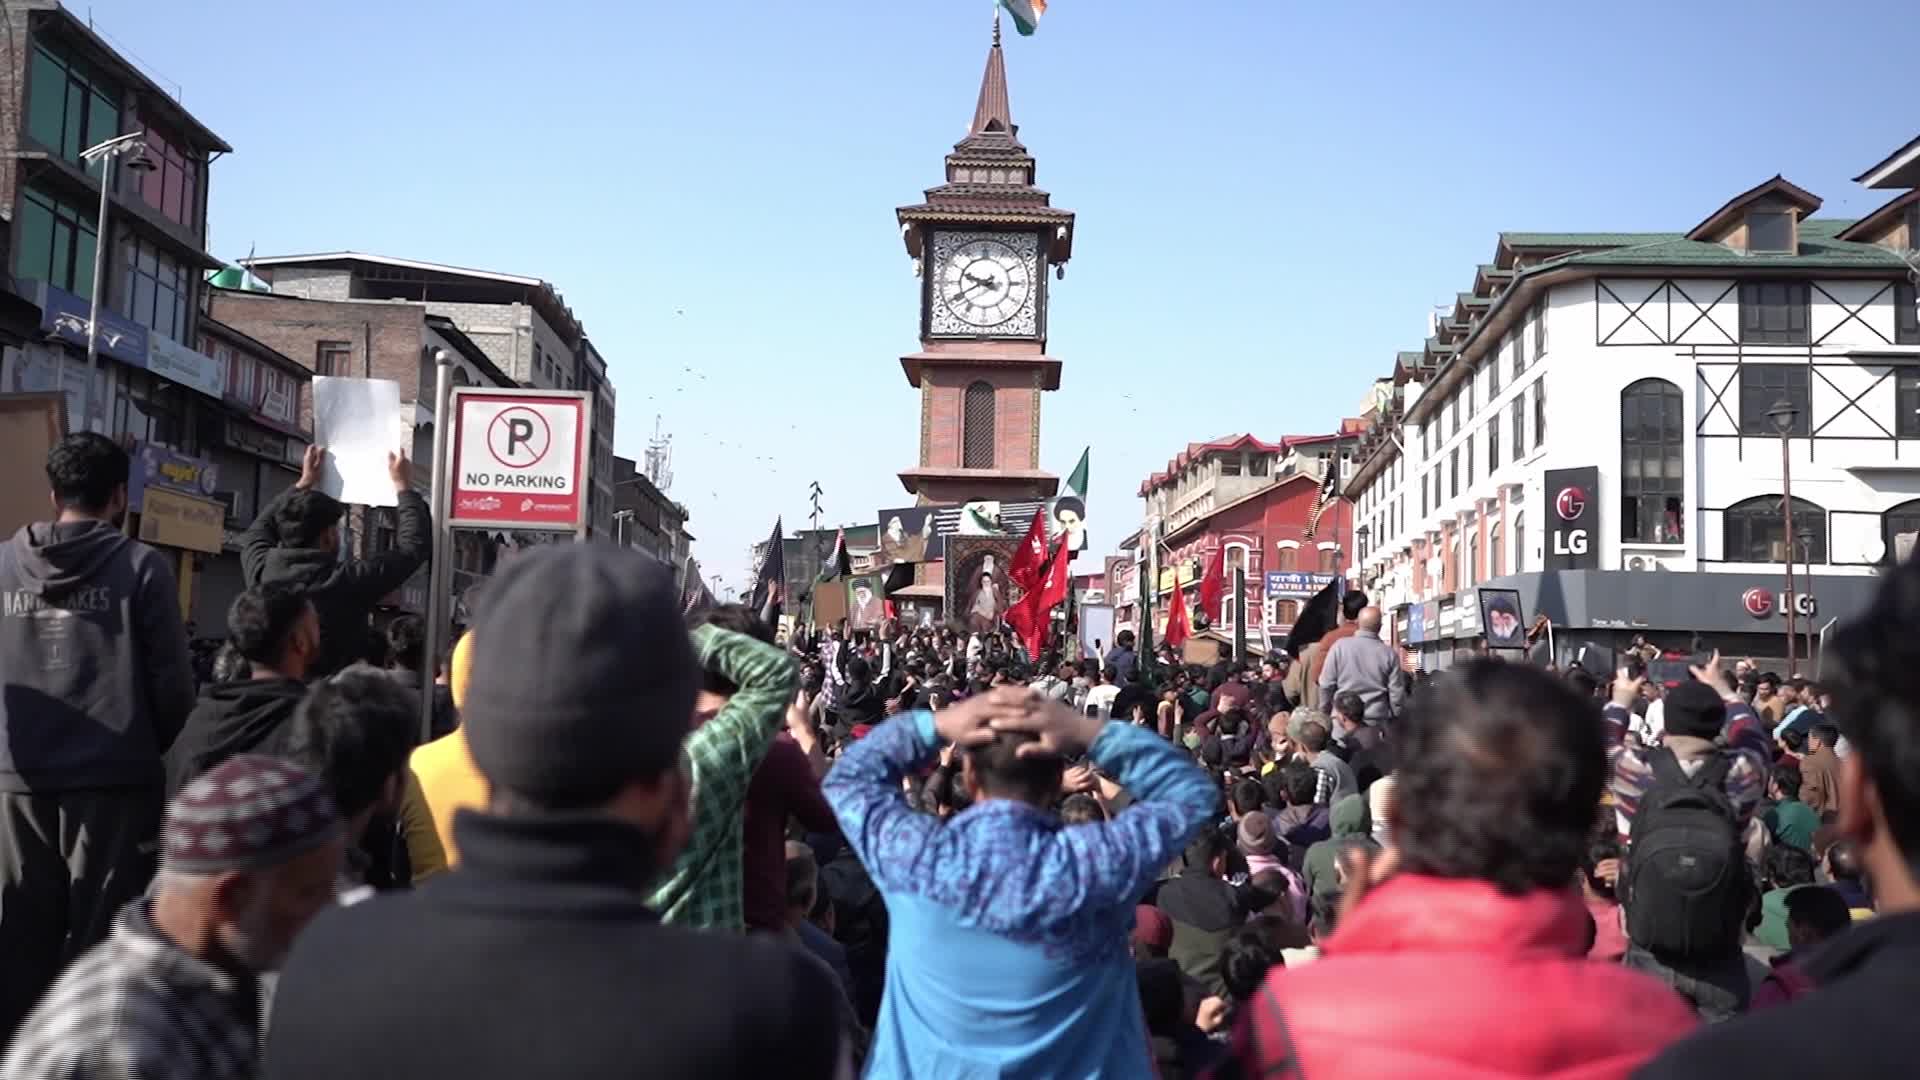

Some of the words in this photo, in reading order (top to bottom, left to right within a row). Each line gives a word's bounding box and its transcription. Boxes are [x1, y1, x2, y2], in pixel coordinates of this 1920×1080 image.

[508, 418, 534, 456] P
[466, 473, 490, 486] NO
[495, 474, 566, 489] PARKING
[1554, 529, 1588, 555] LG
[1271, 583, 1301, 591] YATRI
[1779, 592, 1815, 615] LG
